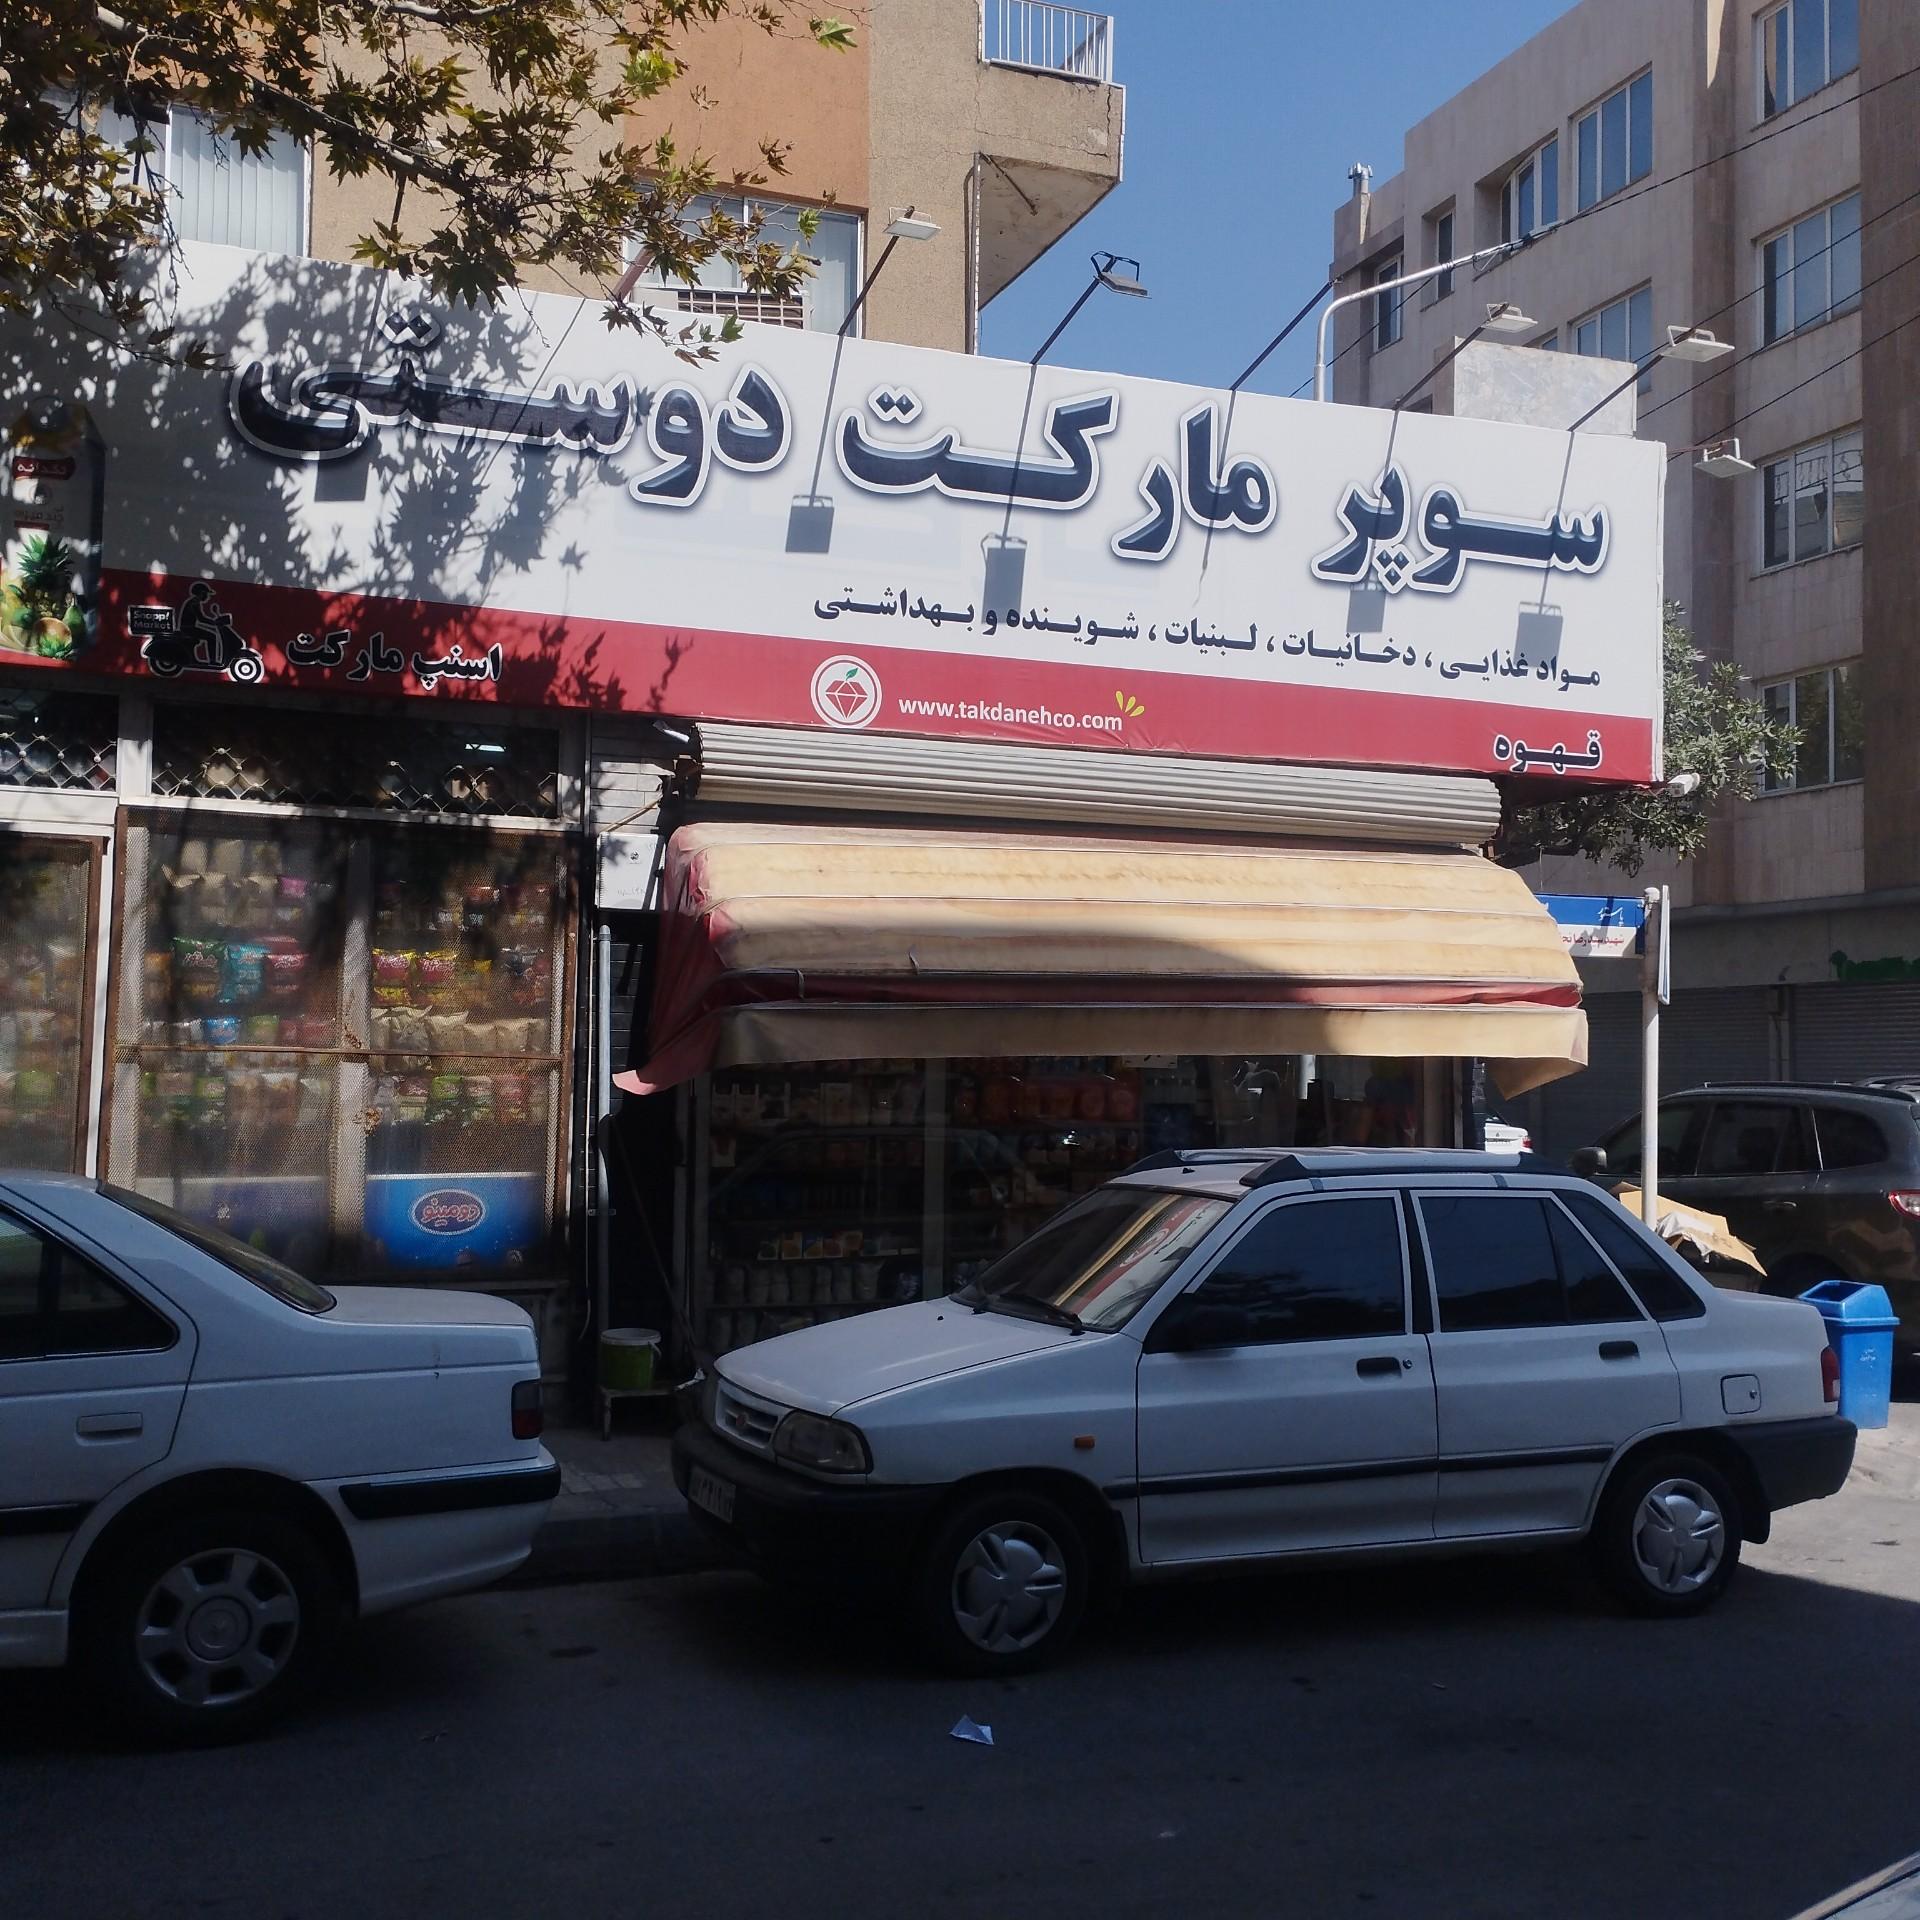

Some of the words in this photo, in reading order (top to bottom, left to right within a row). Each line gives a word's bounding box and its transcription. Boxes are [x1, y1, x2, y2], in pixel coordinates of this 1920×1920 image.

[230, 306, 791, 505] دوستی
[837, 385, 1276, 559] مارکت
[1313, 465, 1607, 591] سوپر
[133, 620, 171, 630] Market
[813, 586, 975, 633] بهداشتی
[982, 609, 998, 636] و
[1005, 607, 1139, 647] شوینده
[286, 629, 405, 681] مارکت
[412, 643, 502, 690] اسنپ
[1536, 655, 1601, 692] مواد
[898, 698, 1124, 732] www.takdanehco.com
[1493, 729, 1603, 774] قهوه
[420, 1197, 481, 1228] دومینو
